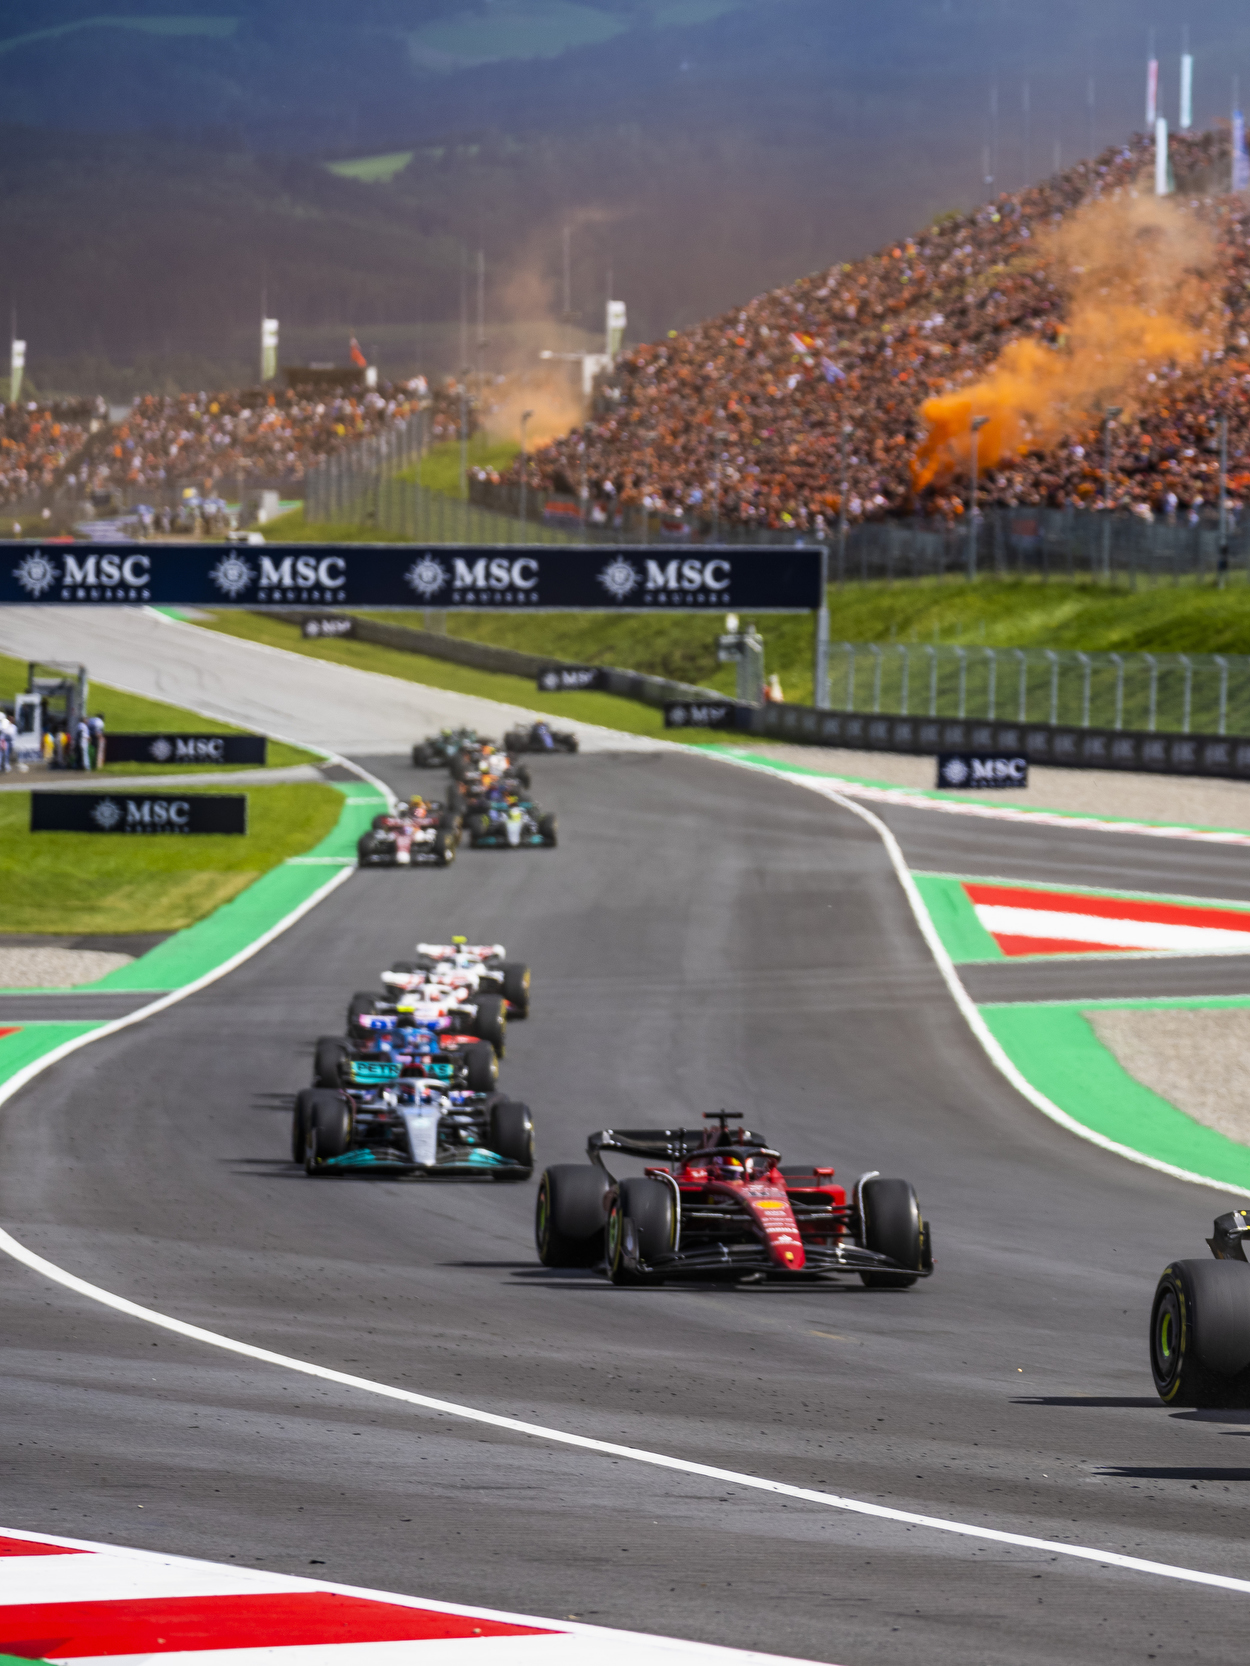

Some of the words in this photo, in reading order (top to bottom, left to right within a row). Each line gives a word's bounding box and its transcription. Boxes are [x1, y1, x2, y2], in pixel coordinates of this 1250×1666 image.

[62, 554, 151, 587] MSC
[258, 556, 347, 588] MSC
[452, 557, 540, 590] MSC
[644, 559, 732, 591] MSC
[174, 737, 225, 758] MSC
[972, 758, 1027, 779] MSC
[125, 800, 190, 825] MSC
[357, 1063, 447, 1075] PETRAS
